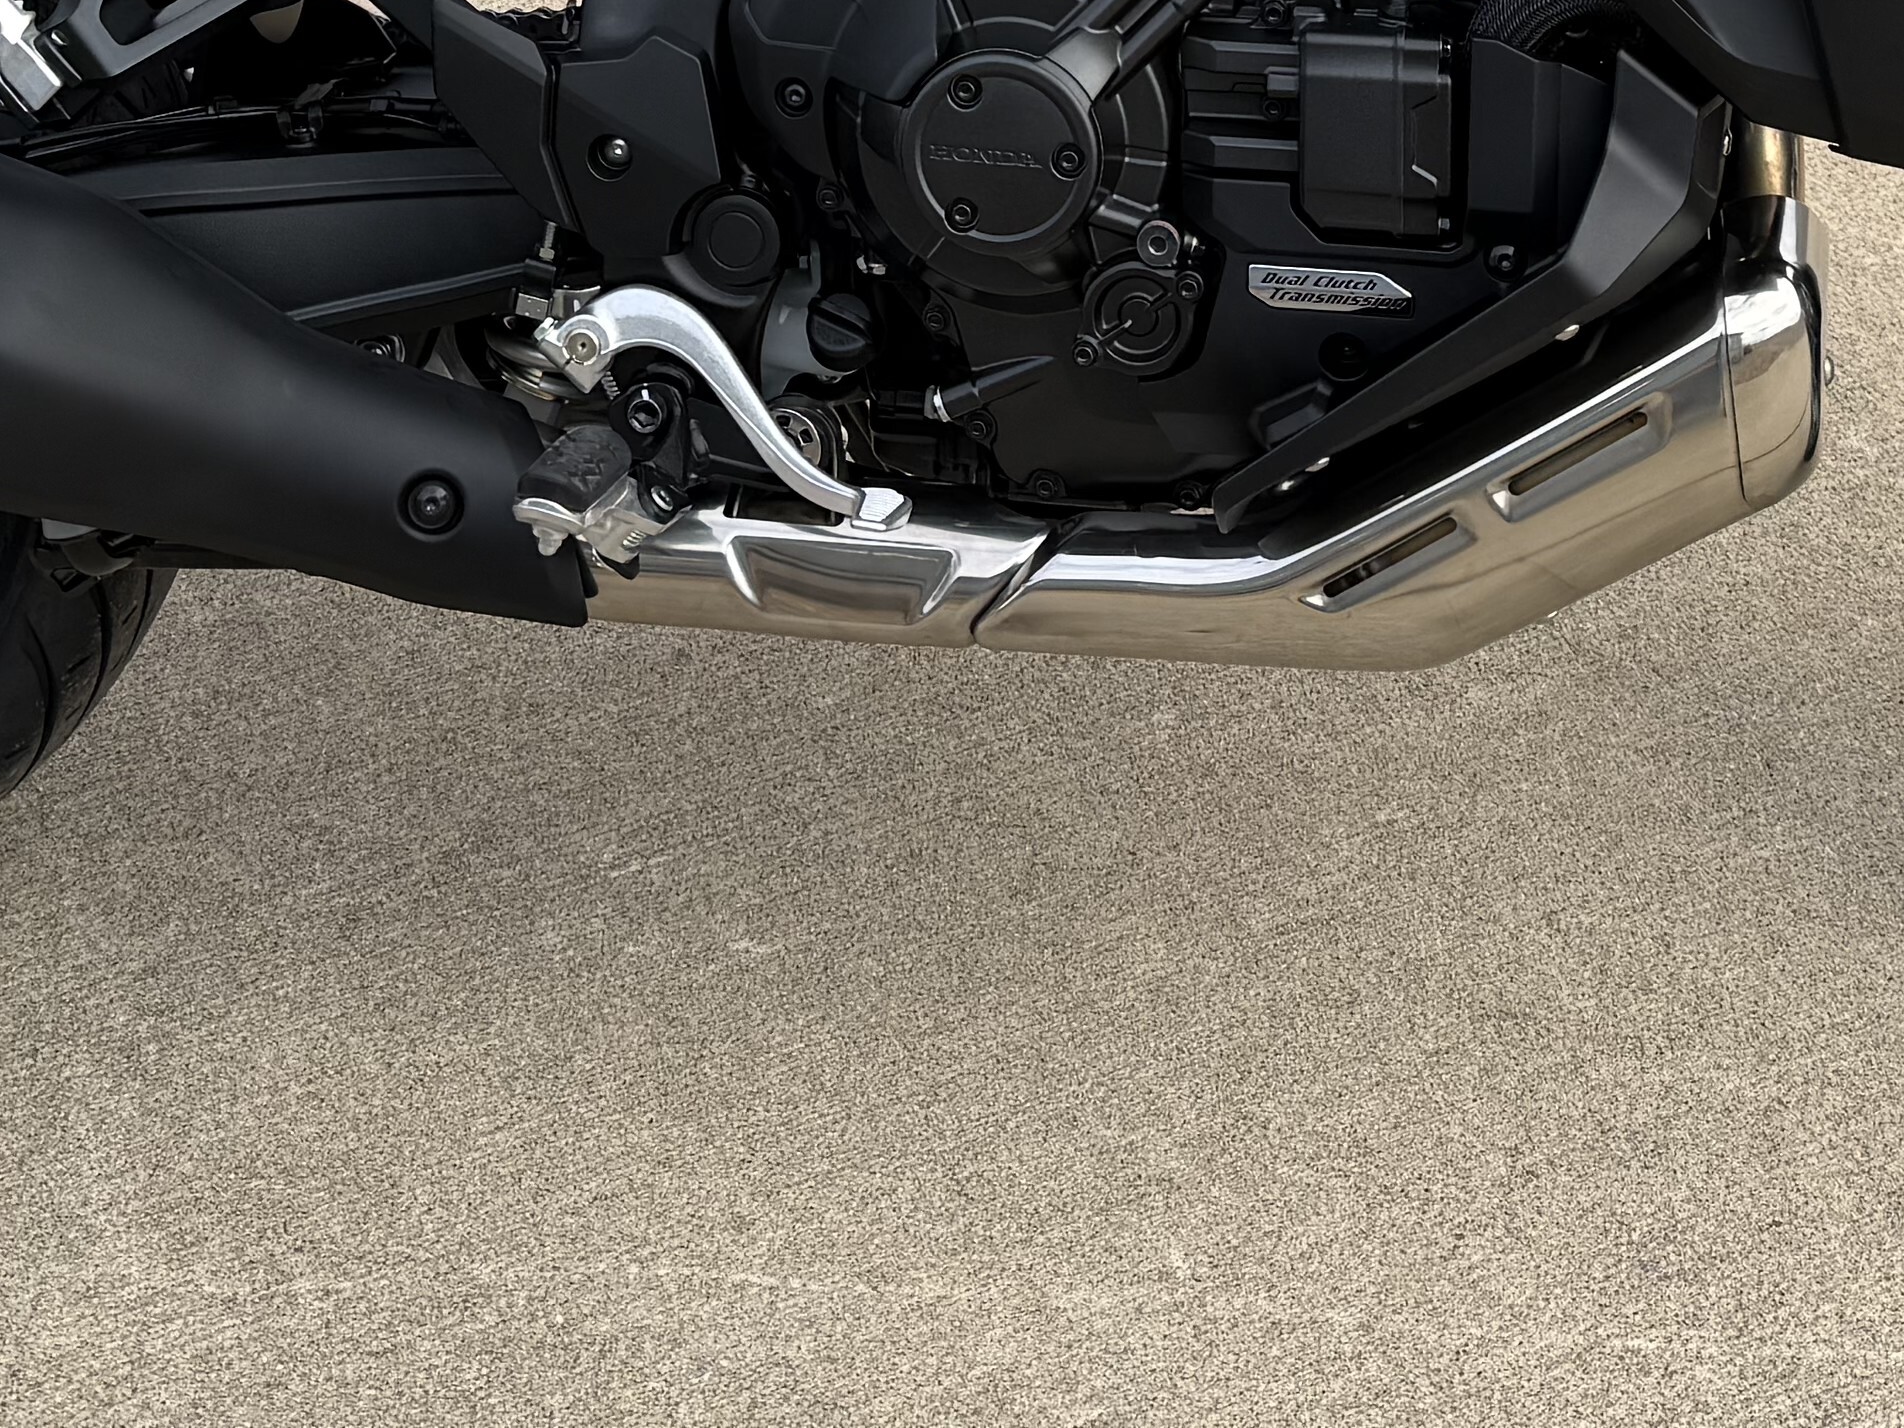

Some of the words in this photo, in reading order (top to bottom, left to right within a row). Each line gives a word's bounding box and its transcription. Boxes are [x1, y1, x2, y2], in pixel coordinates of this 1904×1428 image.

[929, 144, 1043, 169] HONDA
[1260, 272, 1310, 286] Dual
[1313, 275, 1377, 291] Clutch
[1269, 287, 1407, 311] Transmission
